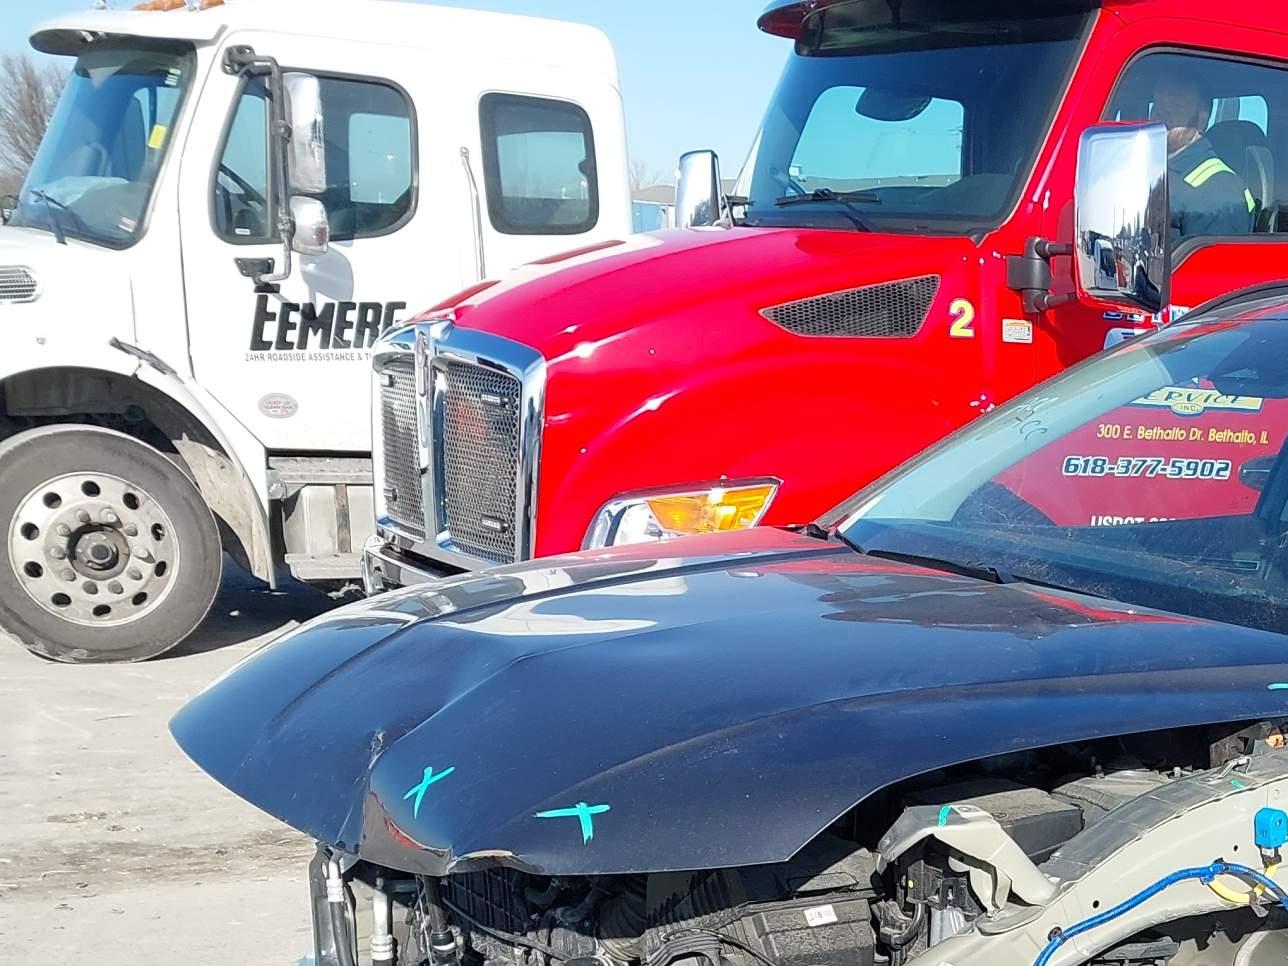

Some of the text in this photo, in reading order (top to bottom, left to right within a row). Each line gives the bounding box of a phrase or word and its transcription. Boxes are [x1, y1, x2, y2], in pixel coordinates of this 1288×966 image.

[949, 297, 975, 338] 2
[245, 353, 265, 361] 24HR
[268, 353, 305, 361] ROADSIDE
[308, 353, 355, 361] ASSISTANCE
[1097, 424, 1269, 445] 300 E. Bethalto Dr. Bethalto, IL
[1063, 456, 1231, 479] 618-377-5902
